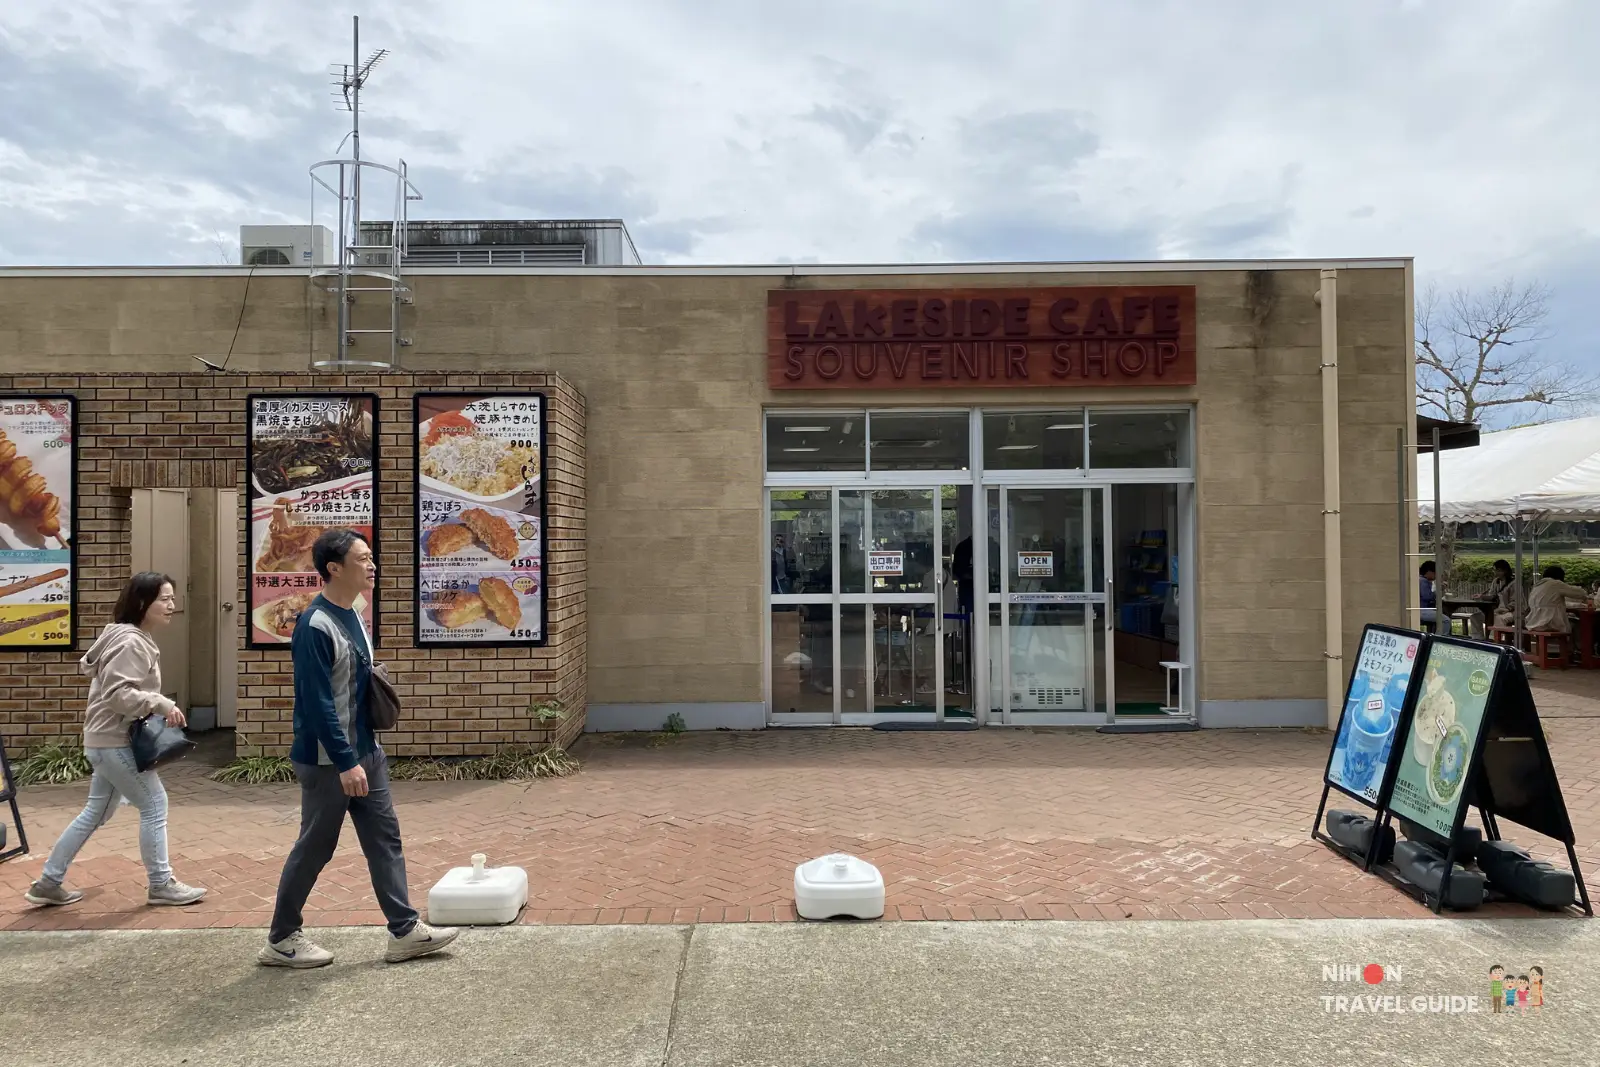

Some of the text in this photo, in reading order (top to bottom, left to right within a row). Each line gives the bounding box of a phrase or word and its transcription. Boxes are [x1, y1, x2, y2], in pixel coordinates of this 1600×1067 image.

[785, 295, 1181, 338] LAKESIDE CAFE
[784, 339, 1181, 380] SOUVENIR SHOP
[256, 401, 349, 414] 濃厚イカスミソース
[465, 402, 538, 412] 大洗しらすのせ
[256, 415, 312, 427] 黒焼きそば
[473, 414, 538, 424] 焼豚やきめし
[510, 440, 539, 448] 900円
[301, 489, 371, 500] かつおだし香る
[285, 502, 371, 513] しょうゆ焼きうどん
[421, 500, 462, 512] 鶏ごぼう
[422, 513, 449, 523] メンチ
[510, 559, 538, 568] 450円
[870, 557, 901, 565] 出口専用
[1023, 557, 1048, 565] OPEN
[421, 579, 470, 590] べにはるか
[421, 591, 457, 601] コロッケ
[509, 629, 538, 638] 450円
